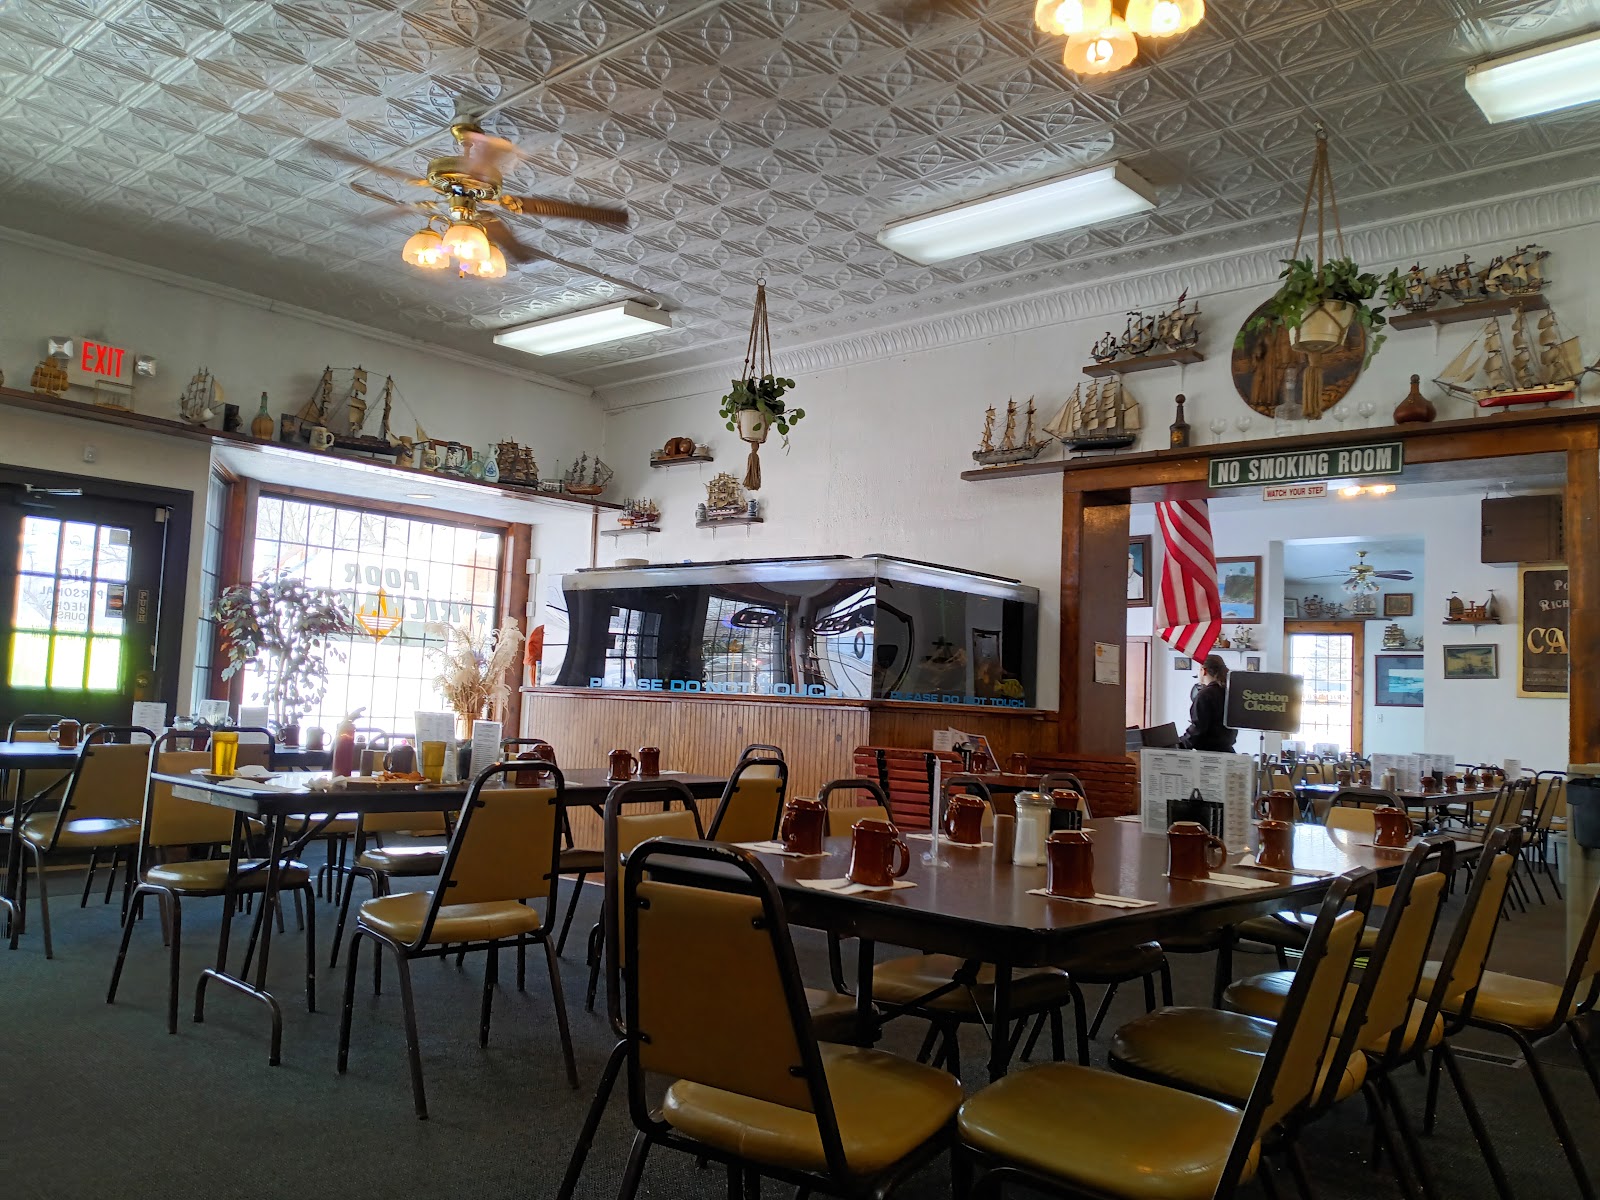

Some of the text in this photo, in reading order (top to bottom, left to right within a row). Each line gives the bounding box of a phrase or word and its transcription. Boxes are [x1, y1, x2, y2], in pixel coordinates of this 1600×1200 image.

[81, 341, 125, 378] EXIT
[1217, 447, 1392, 484] NO SMOKING ROOM
[1266, 485, 1324, 498] WATCH YOUR STEP
[138, 591, 148, 622] PUSH
[590, 677, 845, 698] PLEASE DO NOT TOUCH
[1242, 689, 1289, 702] Section
[891, 691, 1025, 707] PLEASE DO NOT TOUCH
[1243, 700, 1286, 712] Closed
